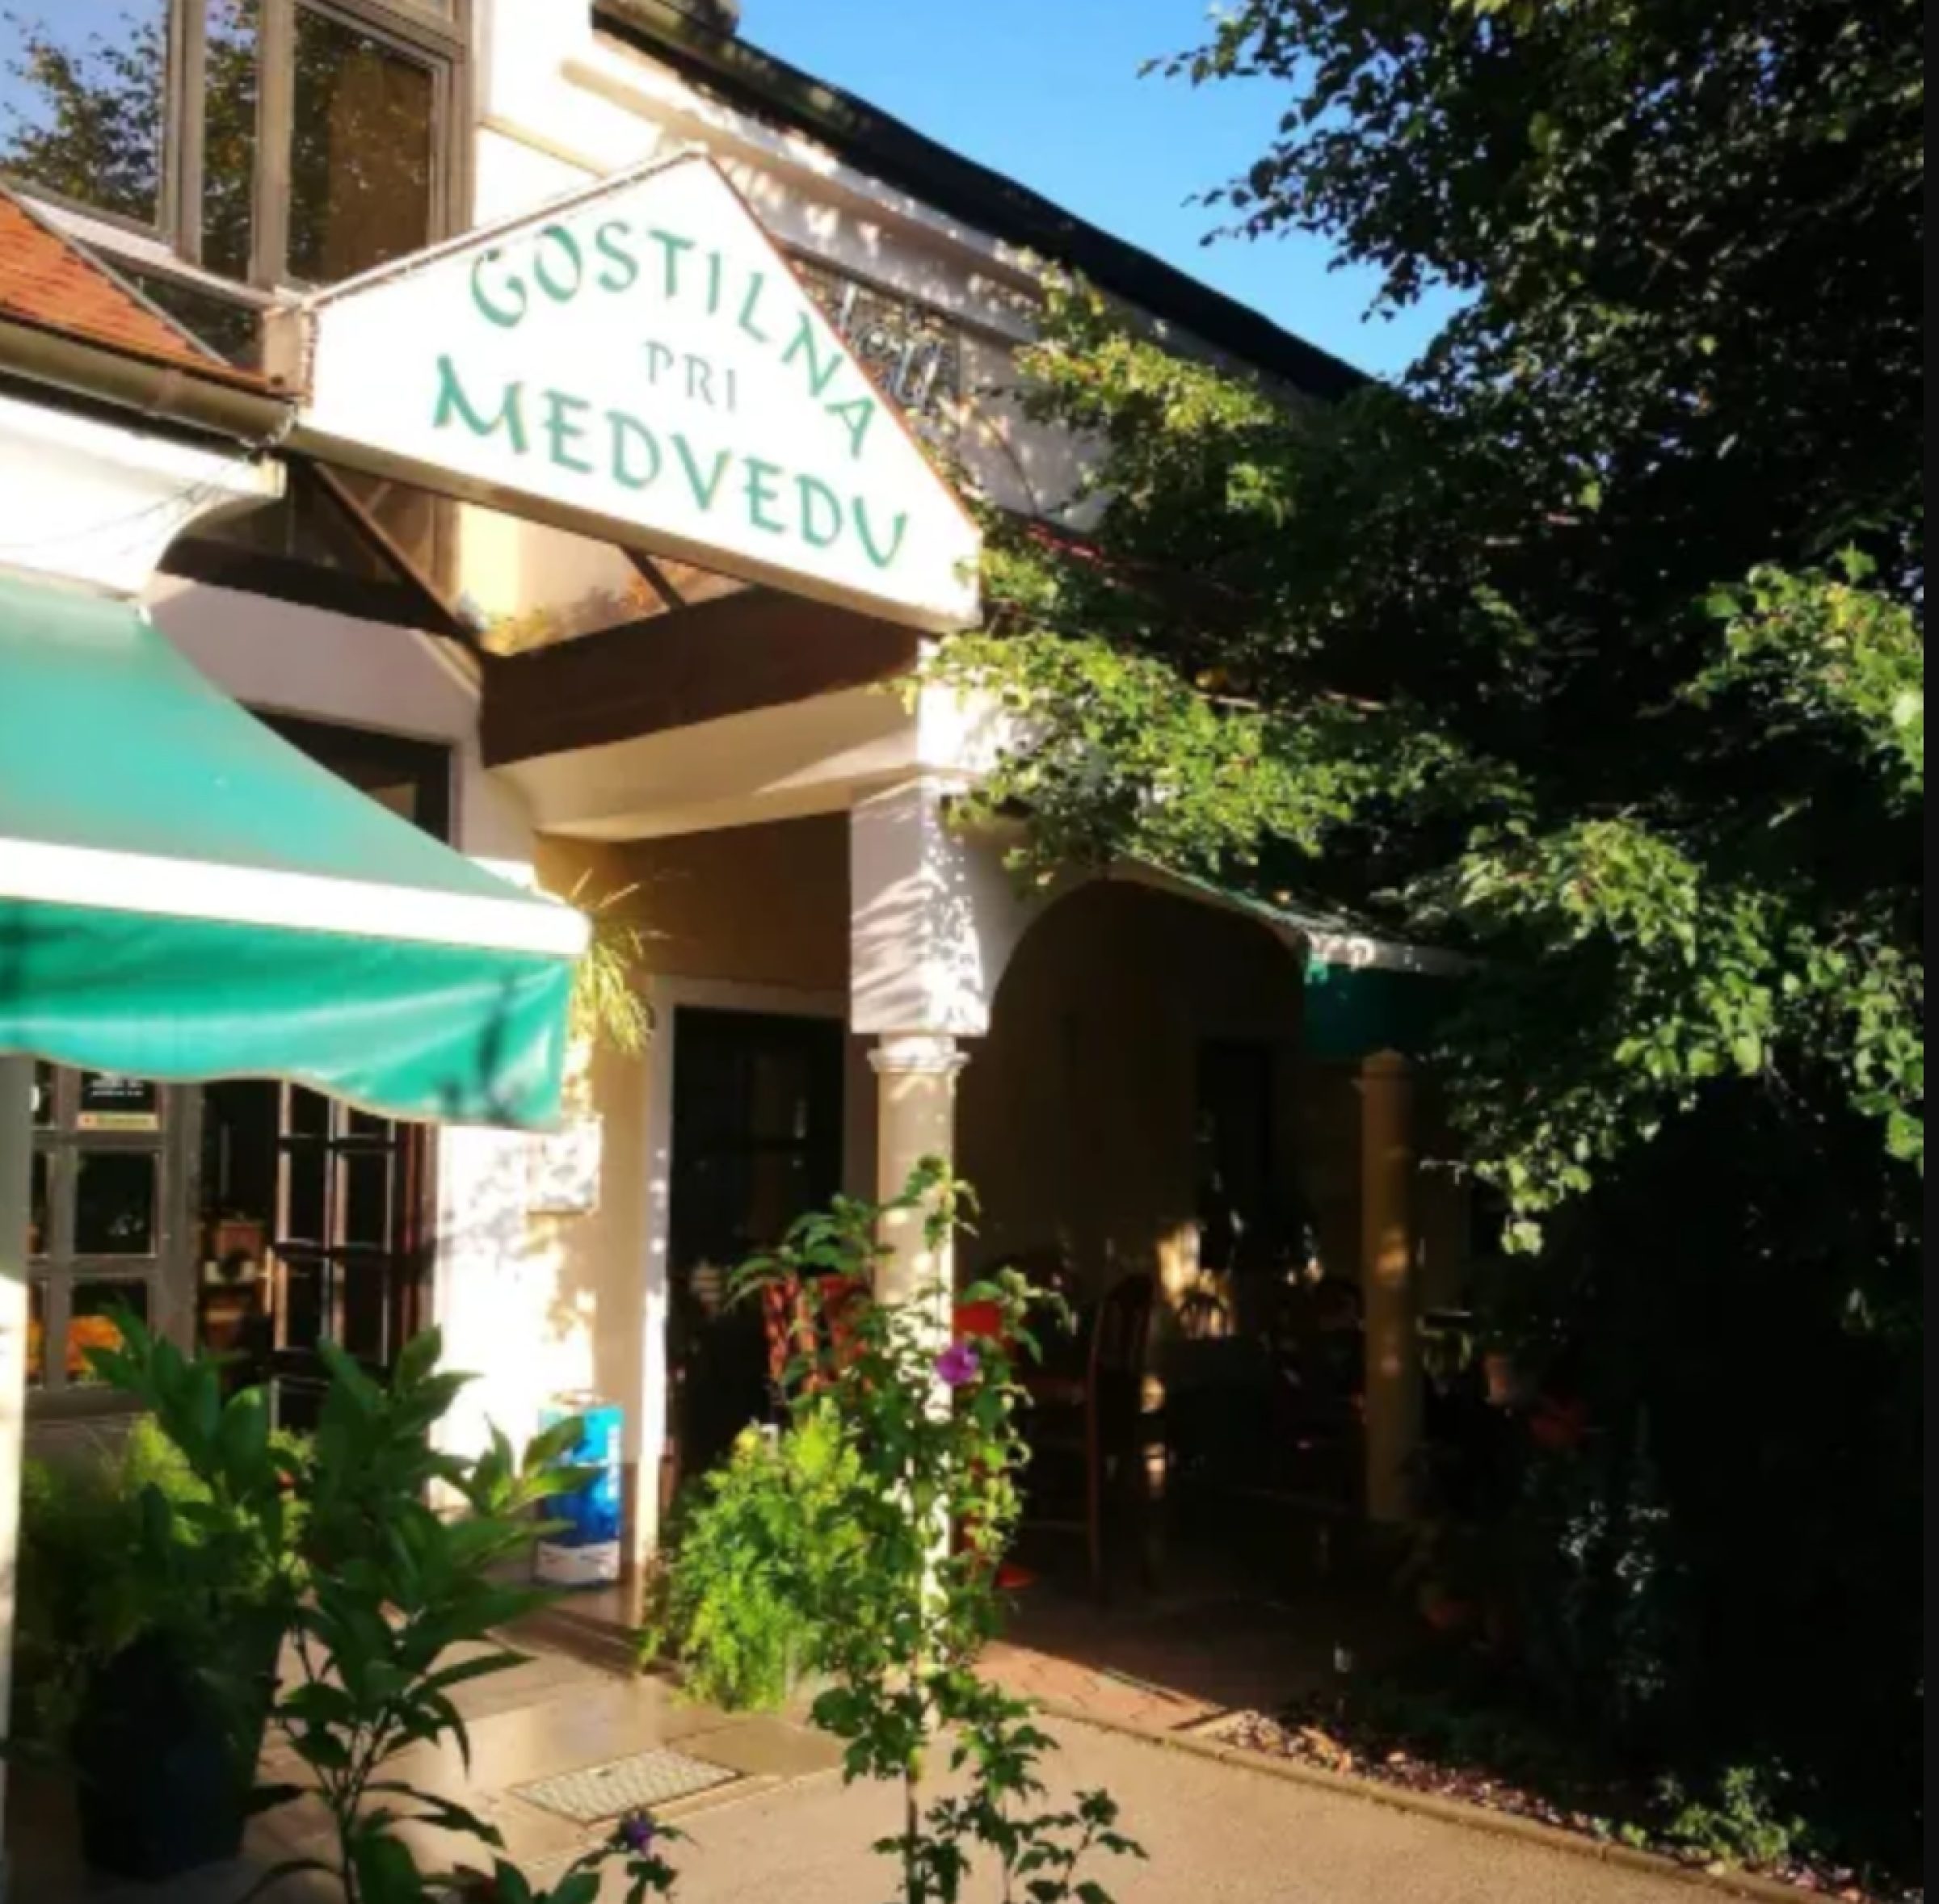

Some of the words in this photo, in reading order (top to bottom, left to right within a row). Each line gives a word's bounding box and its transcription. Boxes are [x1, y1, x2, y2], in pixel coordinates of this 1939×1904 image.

[469, 221, 875, 460] GOSTILNA
[643, 341, 738, 413] PRI
[431, 353, 908, 570] MEDVEDU
